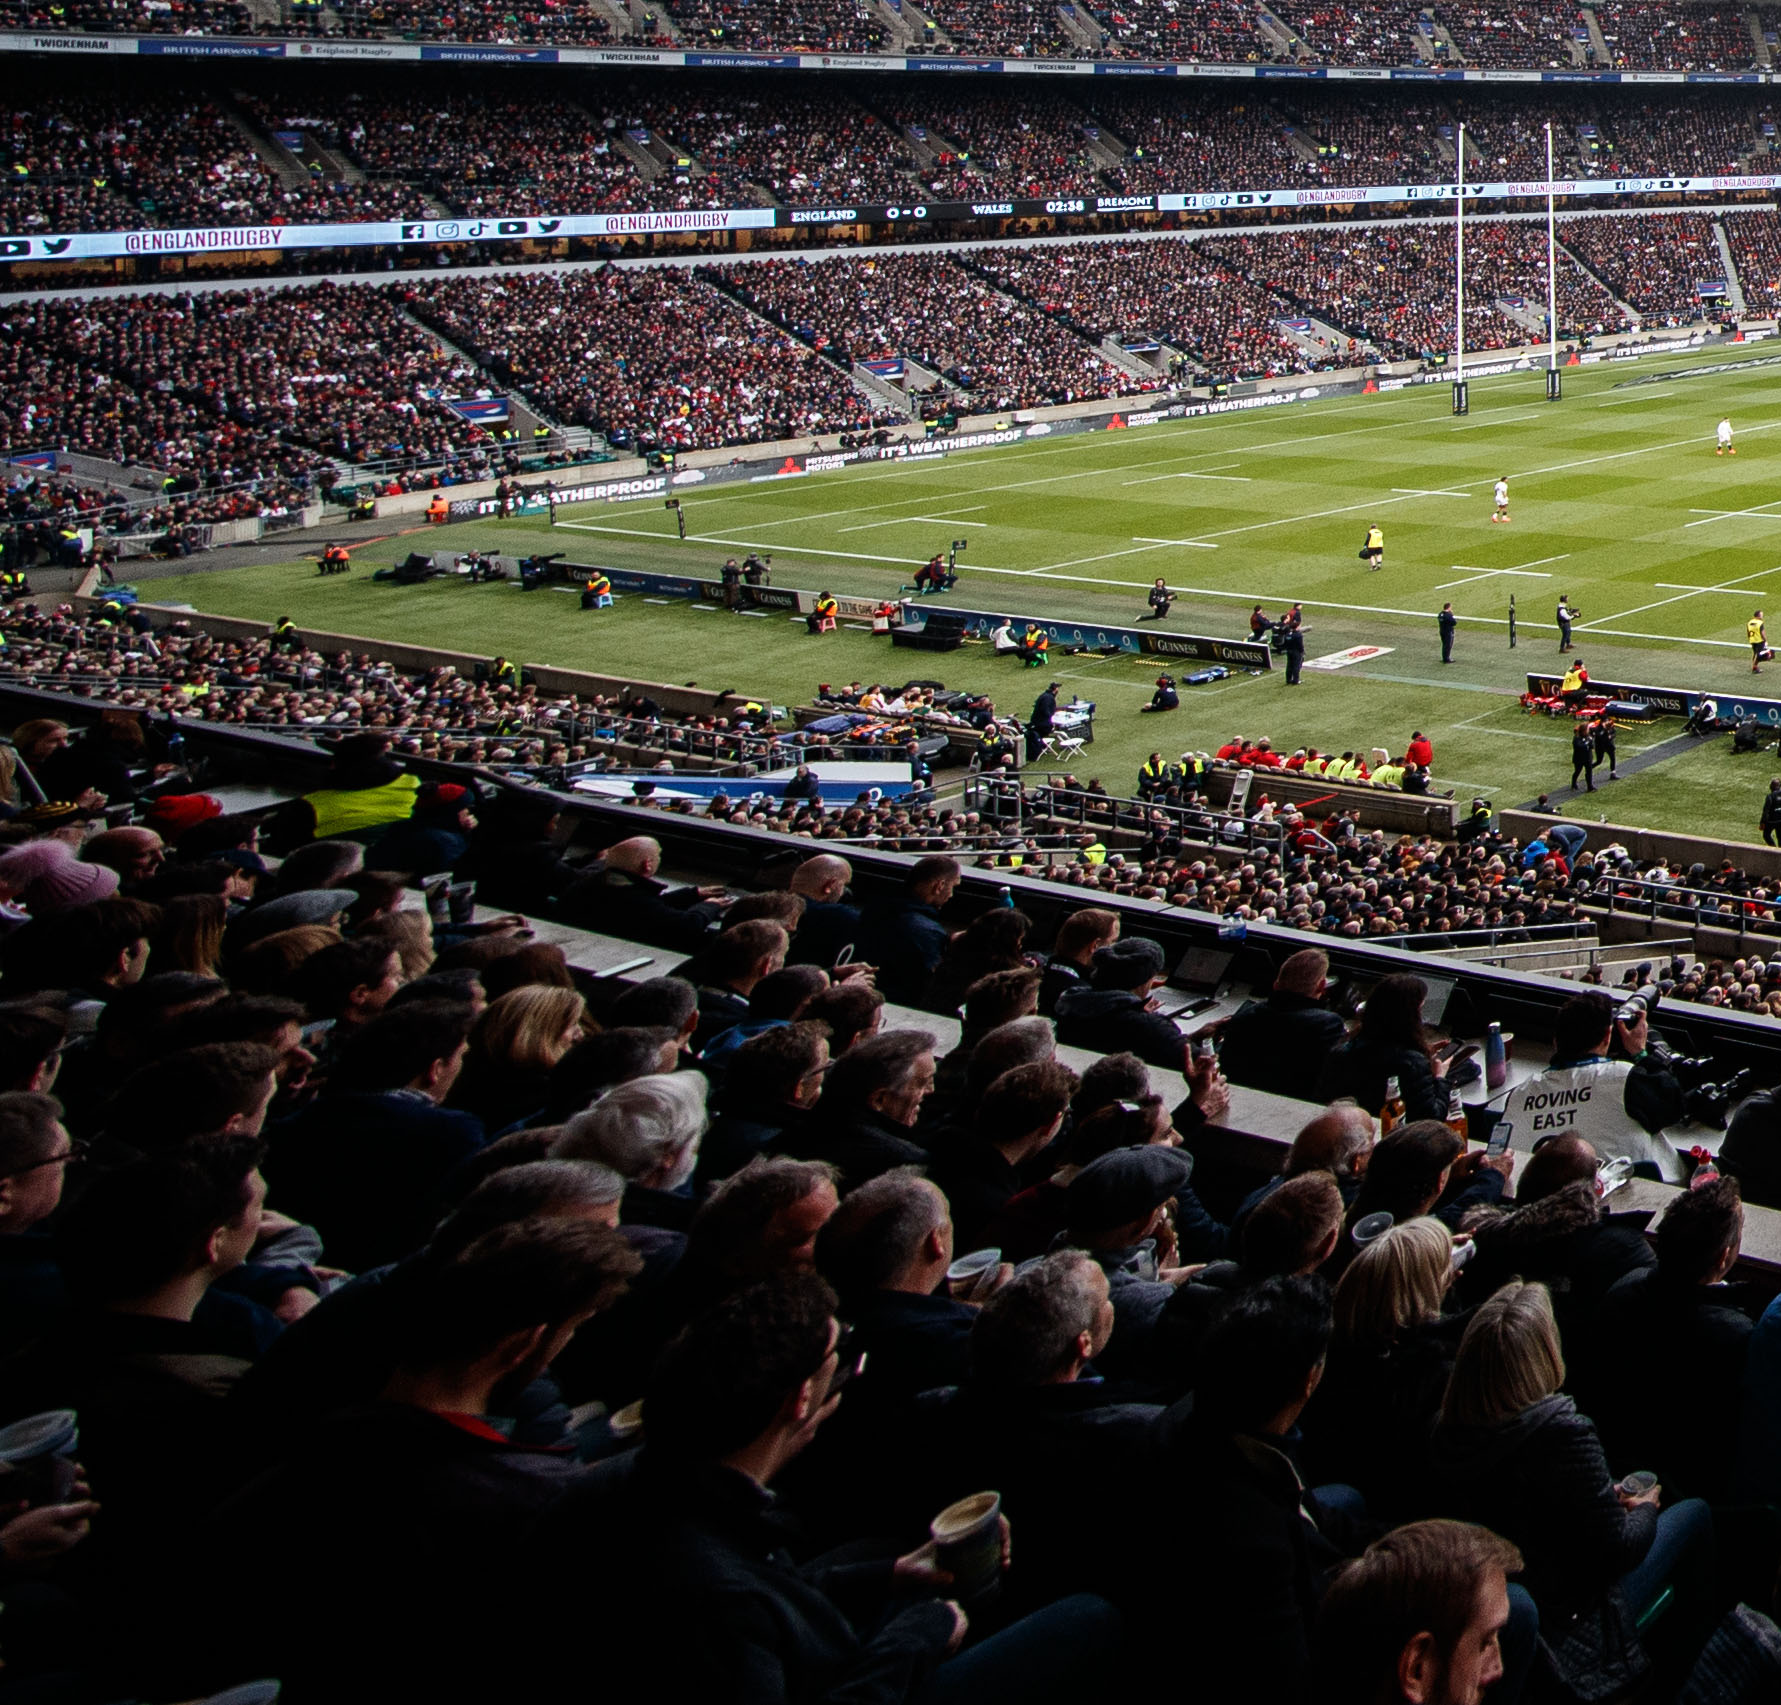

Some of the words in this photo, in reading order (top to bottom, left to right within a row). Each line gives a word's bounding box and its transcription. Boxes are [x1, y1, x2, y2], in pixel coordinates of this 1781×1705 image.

[34, 38, 109, 50] TWICKENHAM
[163, 45, 210, 55] BRITISH
[212, 47, 259, 56] AIRWAYS
[440, 51, 480, 60] BRITISH
[482, 53, 521, 61] AIRWAYS
[601, 53, 660, 62] TWICKENHAM
[1712, 176, 1776, 188] @ENGLANDRUGBY
[1297, 190, 1367, 205] @ENGLANDRUGBY
[791, 209, 857, 223] ENGLAND
[972, 203, 1013, 215] WALES
[1046, 200, 1085, 213] 02:38
[1097, 196, 1153, 208] BREMONT
[606, 212, 729, 232] @ENGLANDRUGBY
[126, 228, 283, 253] @ENGLANDRUGBY
[1617, 347, 1631, 356] IT'S
[1632, 339, 1690, 354] WEATHERPROOF
[1425, 373, 1441, 383] IT'S
[1186, 403, 1207, 416] IT'S
[881, 445, 907, 459] IT'S
[909, 428, 1022, 455] WEATHERPROOF
[806, 451, 859, 465] MITSUBISHI
[806, 459, 845, 472] MOTORS
[1157, 638, 1199, 655] GUINNESS
[1222, 645, 1263, 663] GUINNESS
[1523, 1086, 1593, 1111] ROVING
[1533, 1109, 1577, 1131] EAST
